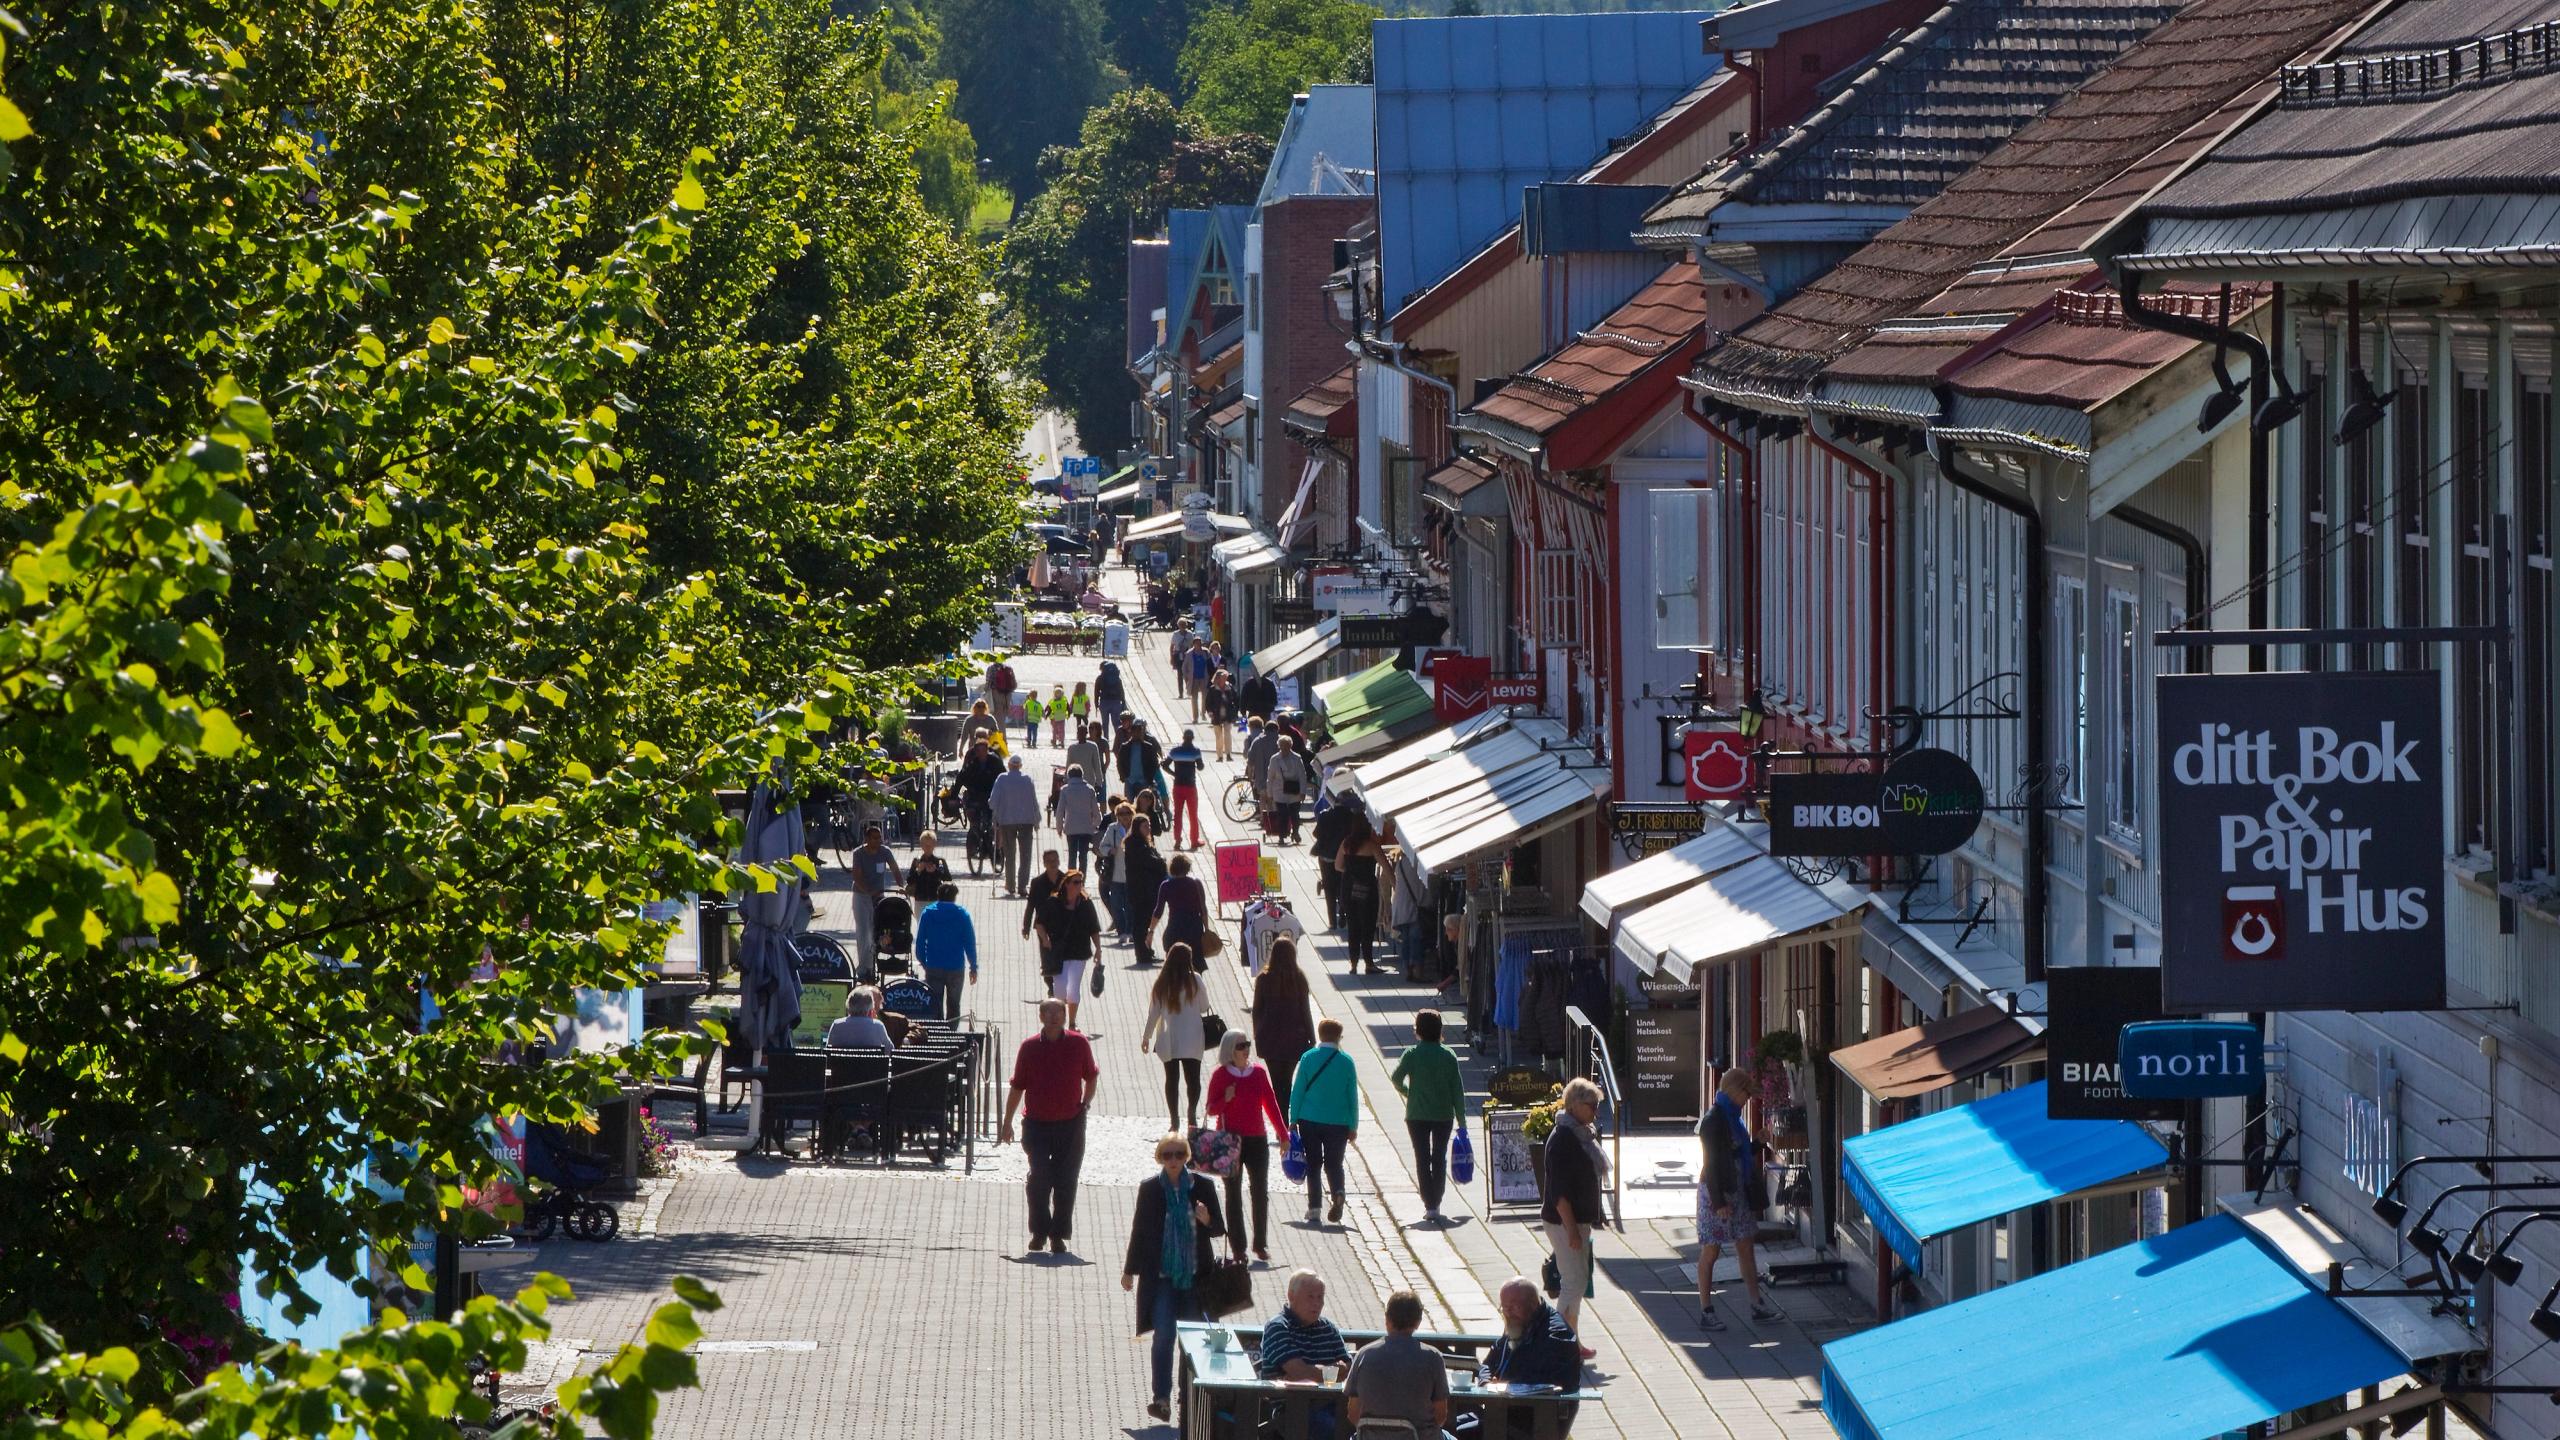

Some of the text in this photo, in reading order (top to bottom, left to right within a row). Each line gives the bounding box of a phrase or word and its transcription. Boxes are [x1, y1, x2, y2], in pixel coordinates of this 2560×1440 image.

[2173, 720, 2422, 785] ditt Bok
[1793, 805, 1835, 828] BIK
[2264, 773, 2320, 830] &
[2219, 808, 2372, 890] Papir
[2306, 874, 2429, 933] Hus
[798, 945, 843, 968] SCANA
[886, 988, 932, 1006] OSCANA
[2137, 1040, 2249, 1076] norli
[1491, 1121, 1522, 1132] diam
